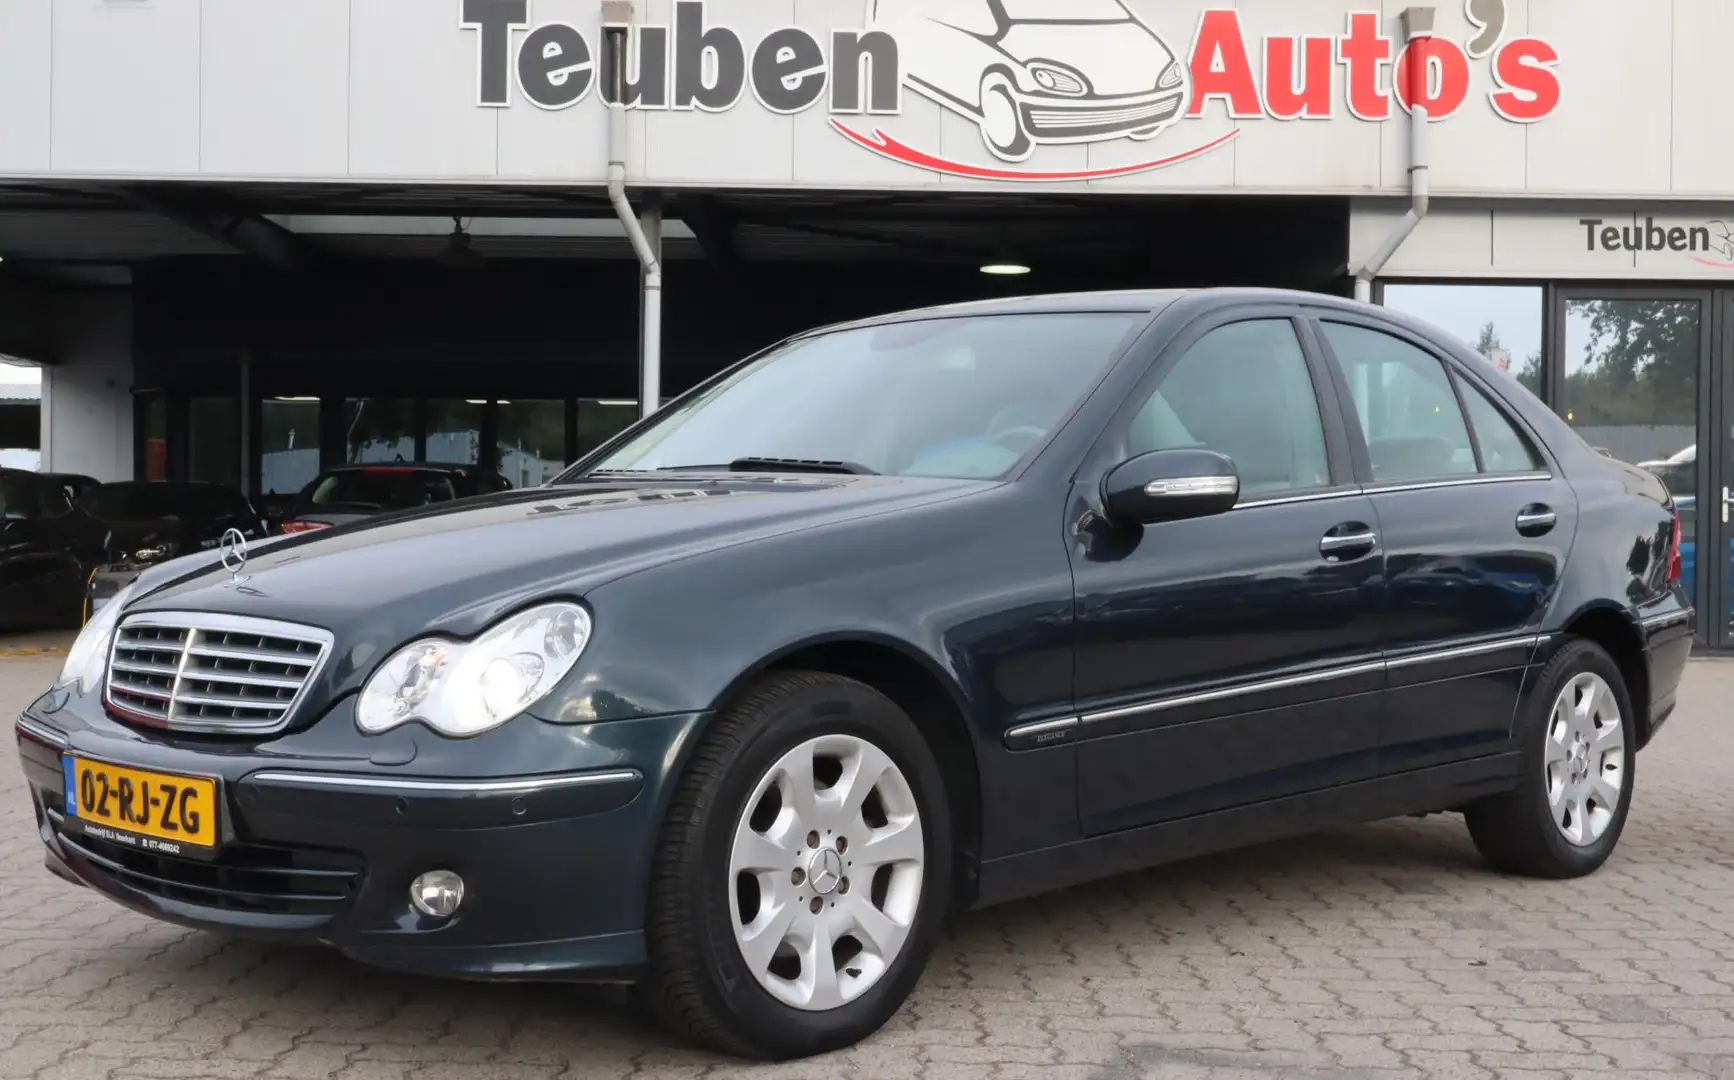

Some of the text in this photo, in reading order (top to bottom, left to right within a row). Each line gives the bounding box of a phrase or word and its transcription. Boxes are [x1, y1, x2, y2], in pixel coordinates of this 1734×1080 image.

[461, 0, 1560, 120] Teuben Auto's
[1579, 216, 1710, 251] Teuben
[81, 768, 200, 834] 02-RJ-ZG
